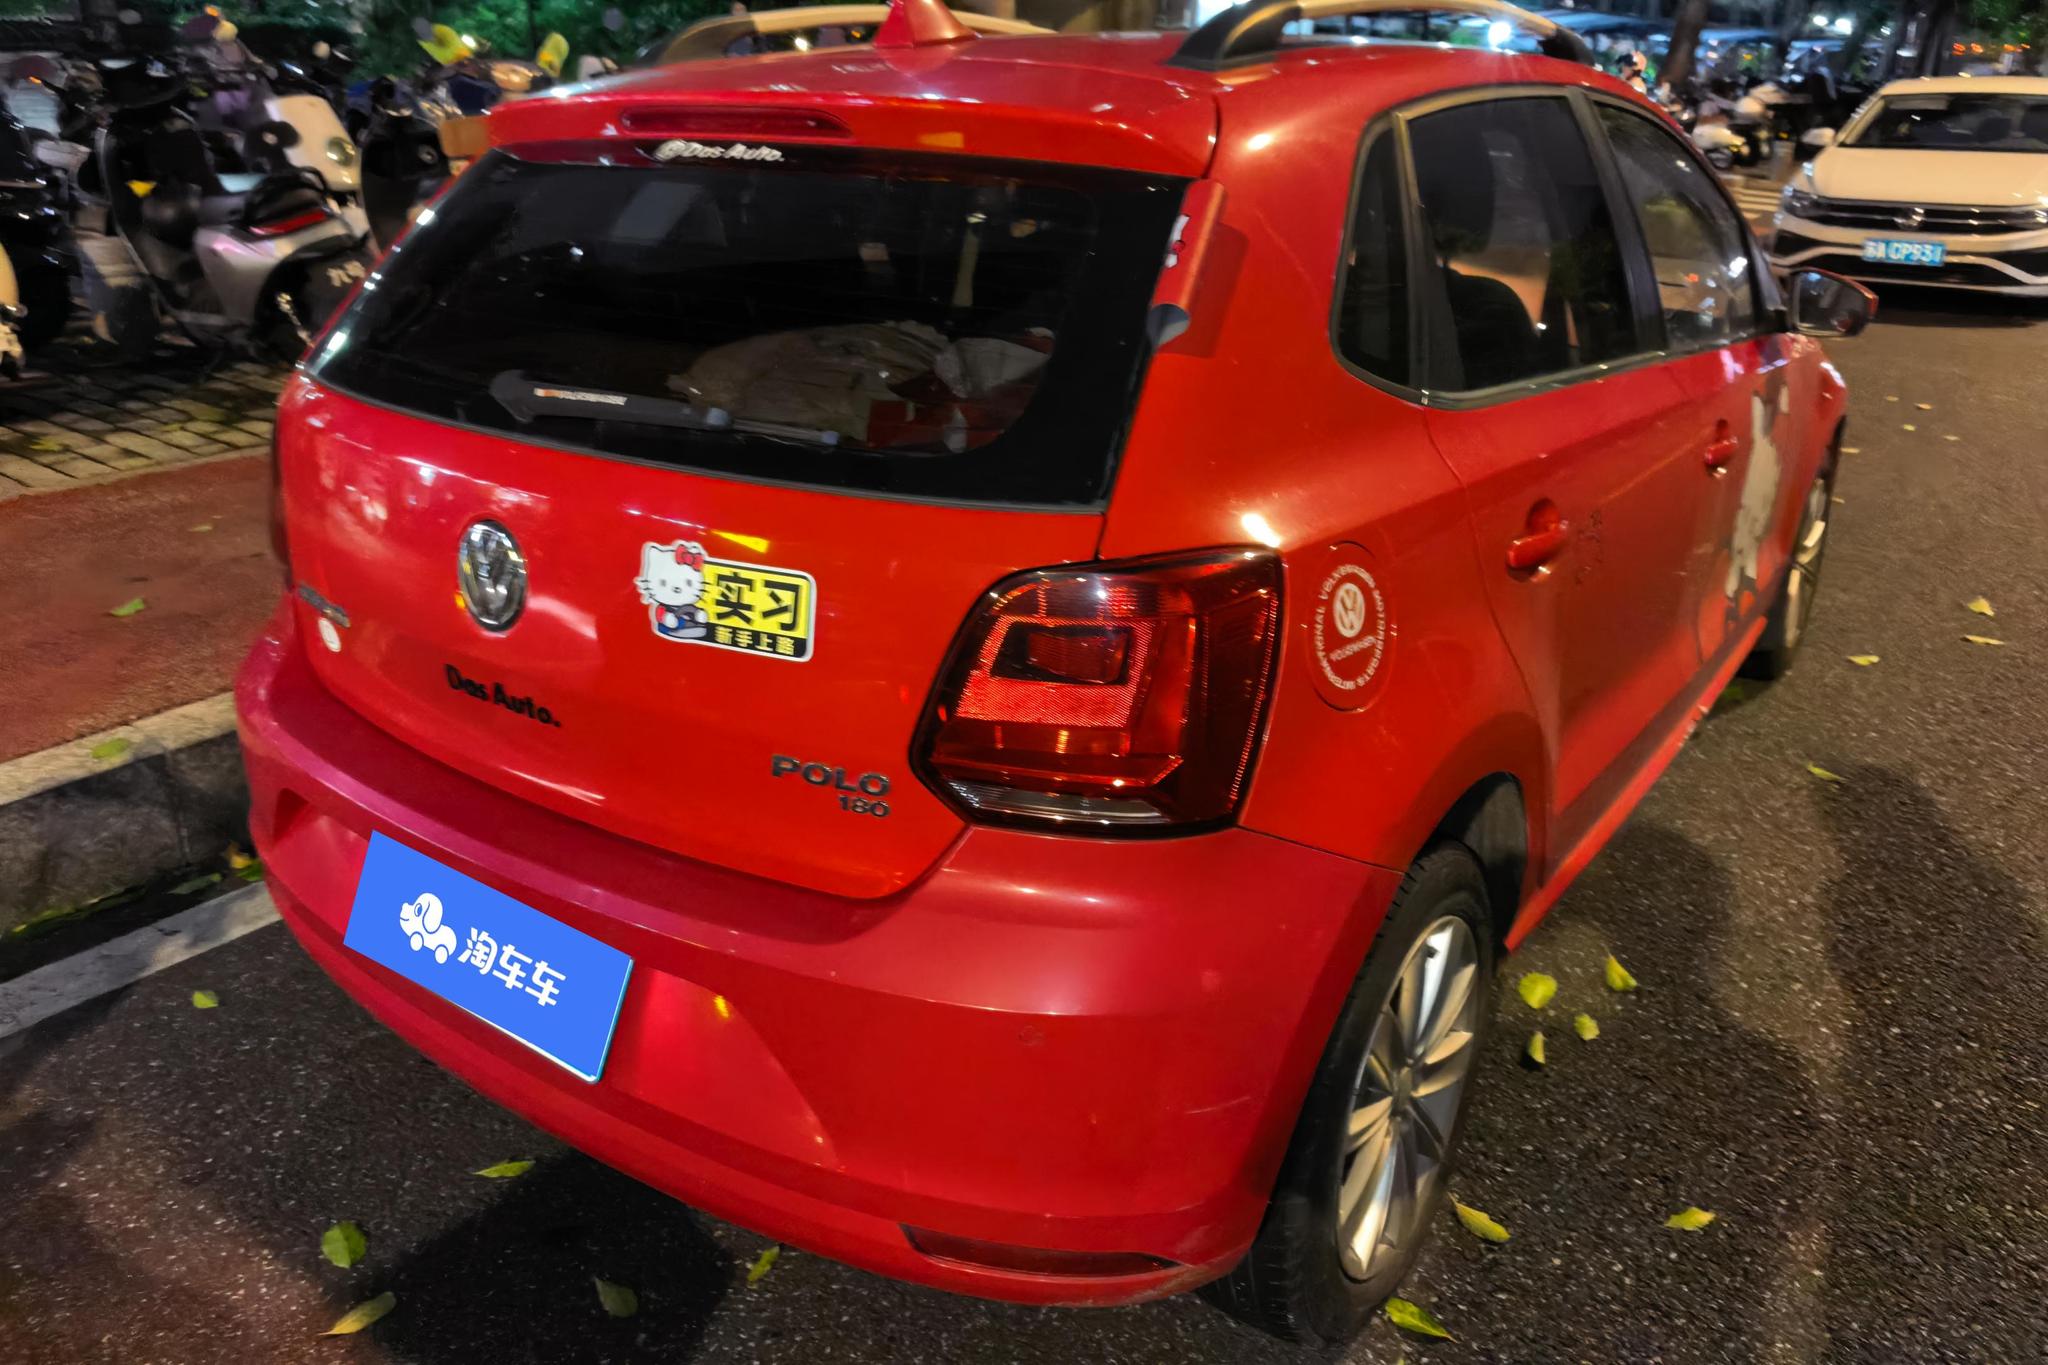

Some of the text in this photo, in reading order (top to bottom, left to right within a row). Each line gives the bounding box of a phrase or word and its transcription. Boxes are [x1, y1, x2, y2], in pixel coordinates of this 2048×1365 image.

[714, 571, 802, 631] 实习
[445, 663, 489, 701] Das
[771, 753, 890, 797] POLO
[839, 794, 890, 818] 180
